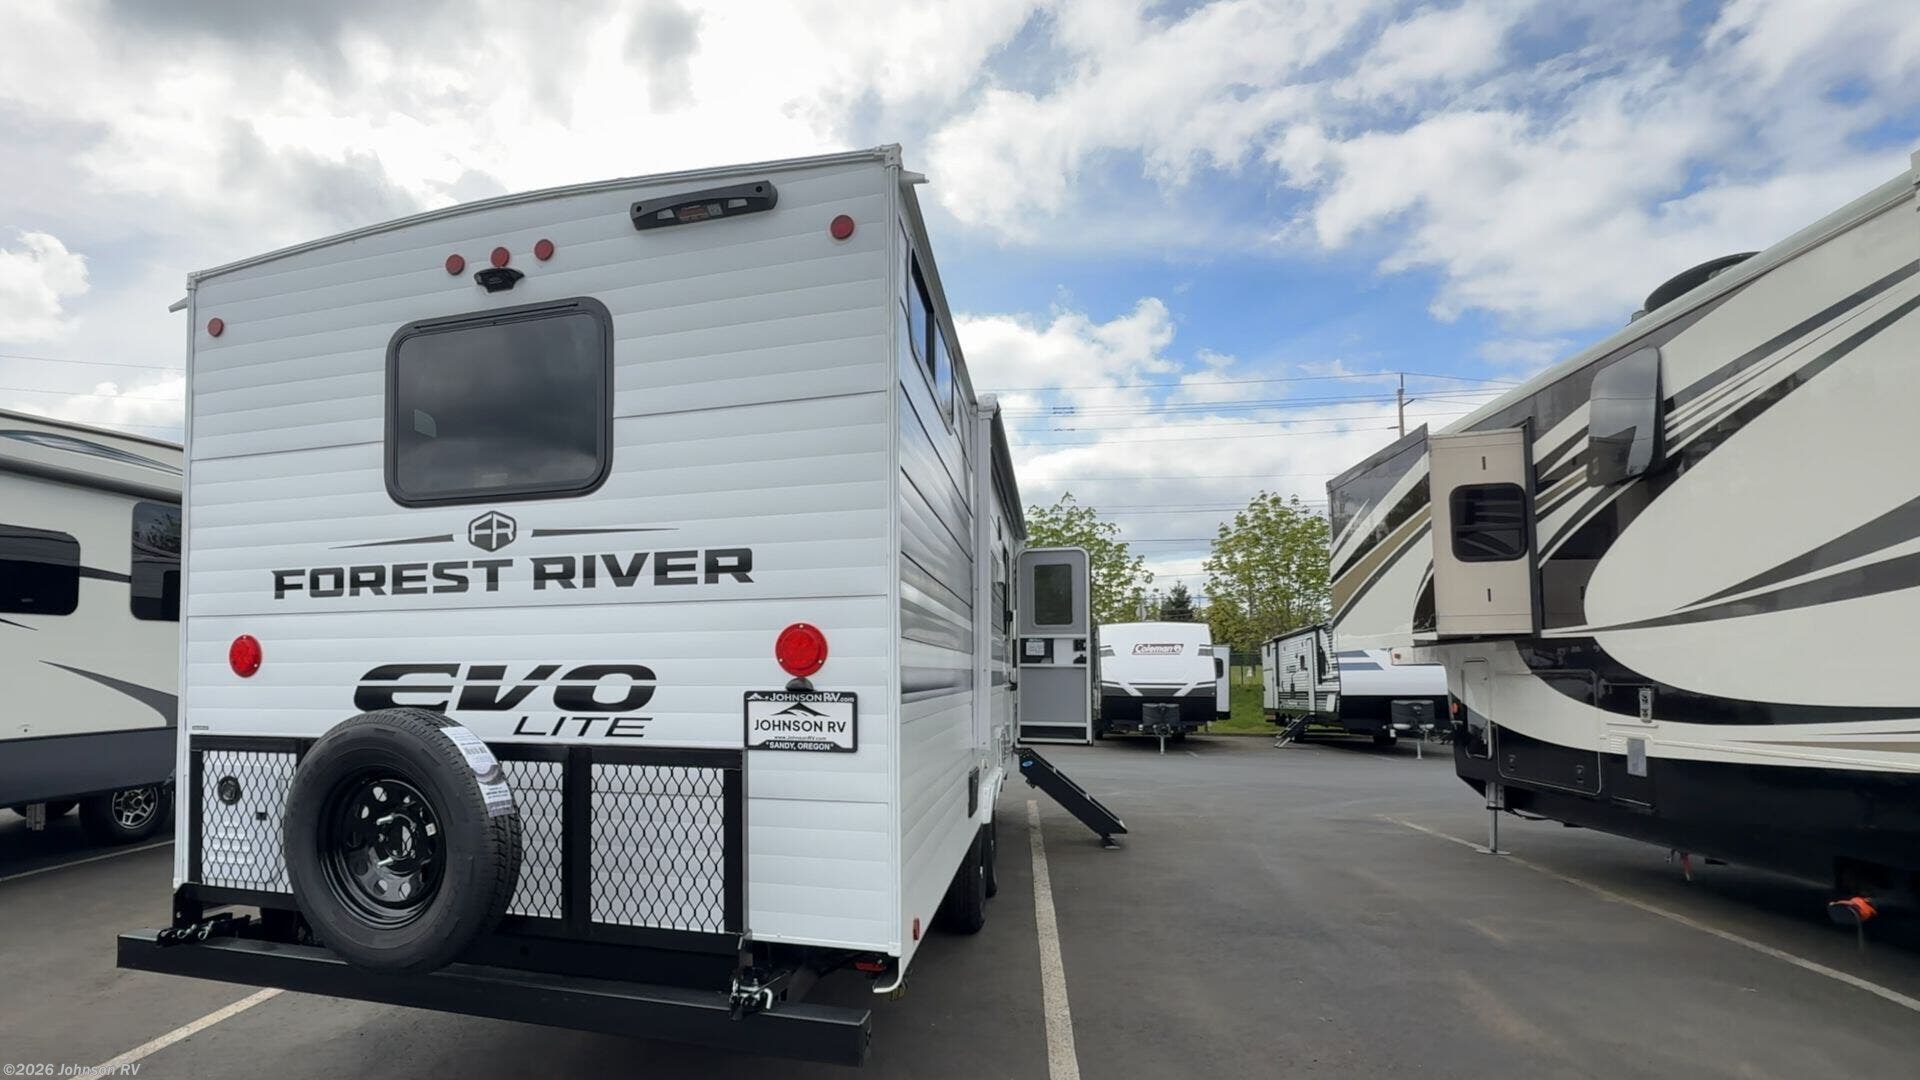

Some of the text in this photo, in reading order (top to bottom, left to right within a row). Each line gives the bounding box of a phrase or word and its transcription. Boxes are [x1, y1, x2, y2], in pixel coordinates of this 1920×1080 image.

[272, 548, 754, 599] FOREST RIVER
[1135, 644, 1176, 654] Coleman
[353, 663, 657, 713] EVO
[513, 716, 653, 738] LITE
[754, 719, 847, 733] JOHNSON RV
